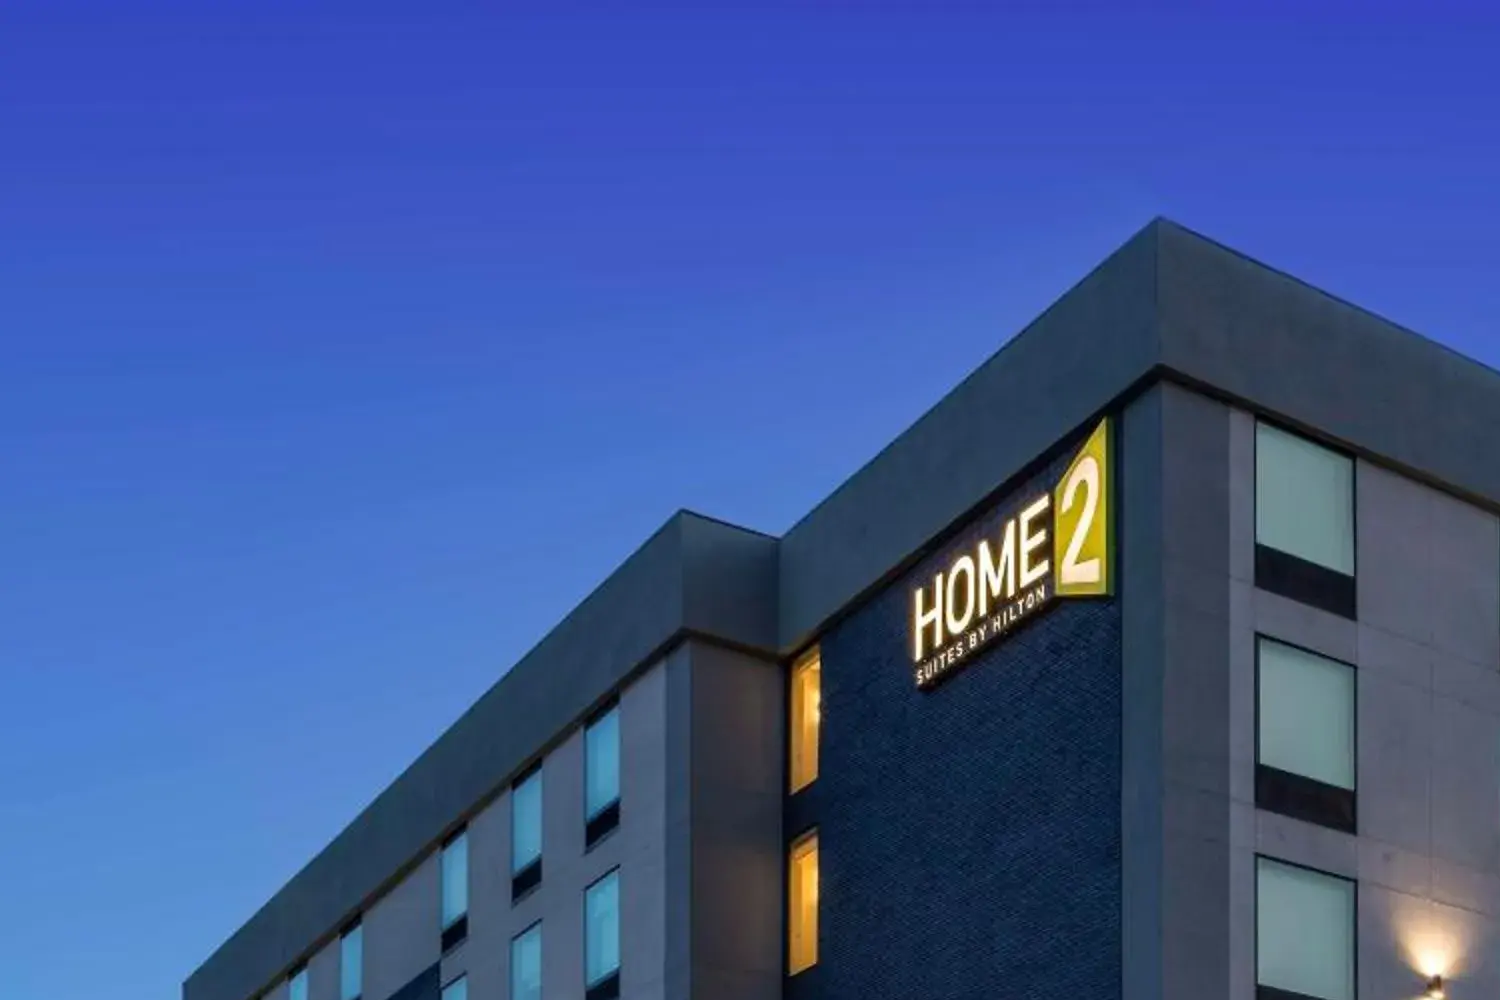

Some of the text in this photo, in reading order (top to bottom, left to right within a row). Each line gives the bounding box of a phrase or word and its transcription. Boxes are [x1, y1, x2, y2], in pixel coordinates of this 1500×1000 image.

[914, 494, 1049, 662] HOME
[916, 583, 1045, 685] SUITES BY HILTON
